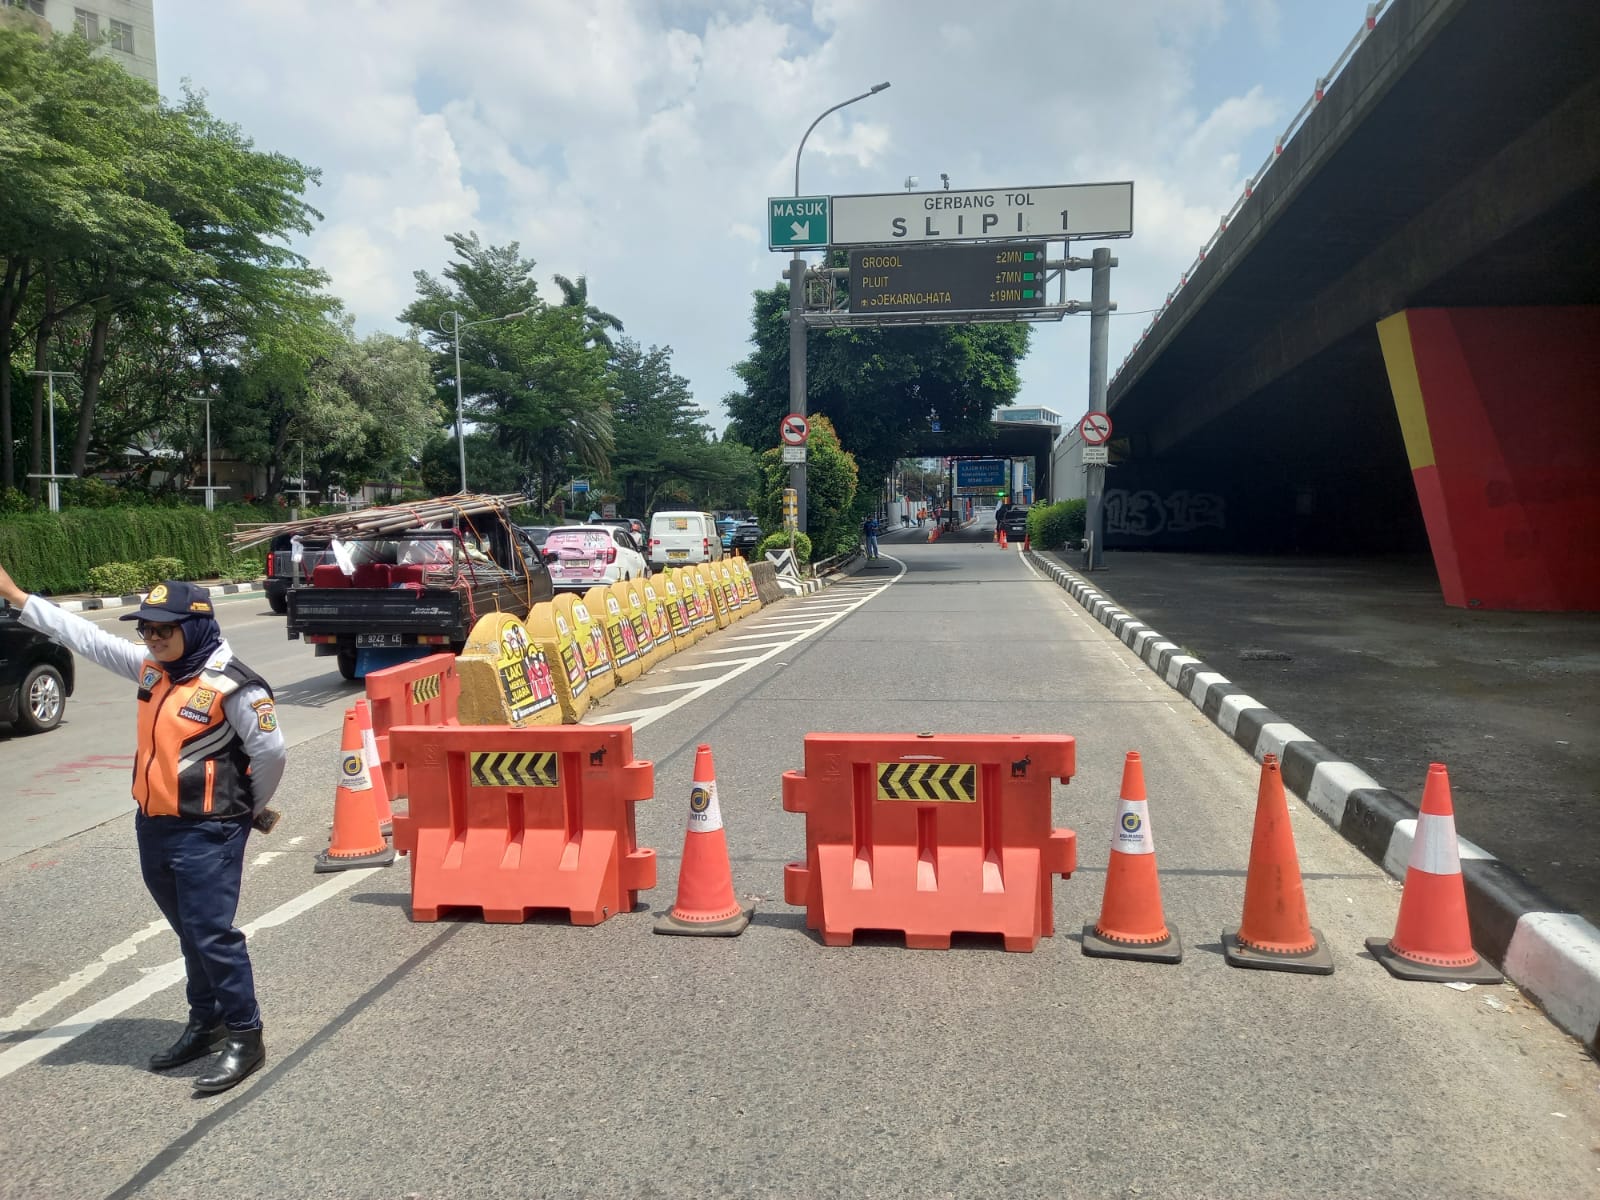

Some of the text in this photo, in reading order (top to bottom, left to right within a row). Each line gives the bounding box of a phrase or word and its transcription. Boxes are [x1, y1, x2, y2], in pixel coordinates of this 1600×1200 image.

[924, 193, 1034, 210] GERBANG TOL
[773, 203, 824, 217] MASUK
[891, 210, 1070, 238] SLIPI 1
[862, 256, 903, 269] GROGOL
[862, 276, 889, 289] PLUIT
[357, 635, 363, 643] B
[504, 663, 523, 681] LAKI
[181, 708, 208, 722] DISHUB
